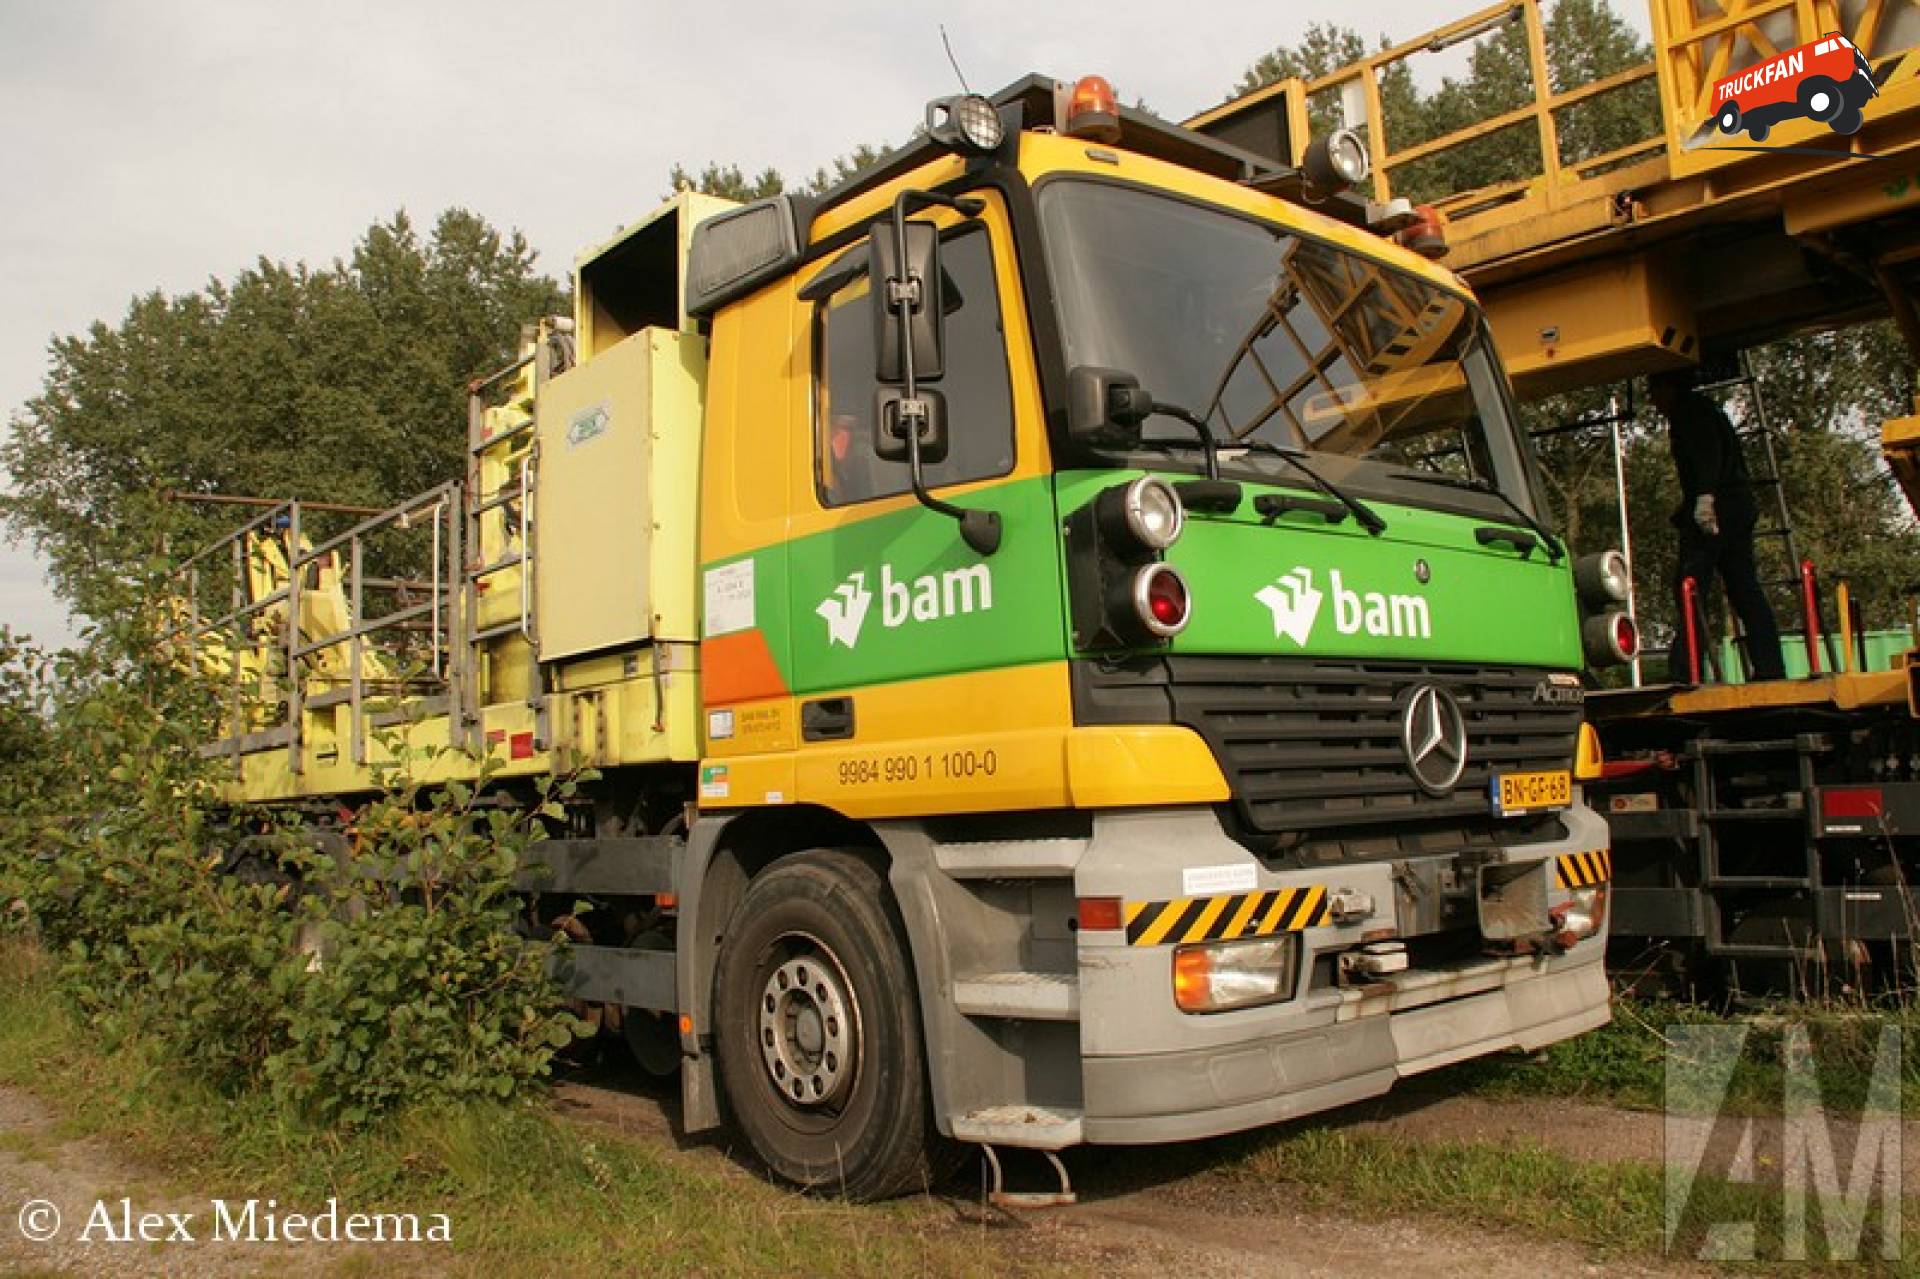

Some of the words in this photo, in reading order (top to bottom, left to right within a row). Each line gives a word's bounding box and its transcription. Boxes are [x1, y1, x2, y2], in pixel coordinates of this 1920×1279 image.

[881, 563, 992, 627] bam
[1329, 568, 1431, 640] bam
[839, 760, 879, 785] 9984
[885, 755, 918, 782] 990
[924, 755, 932, 780] 1
[942, 749, 997, 778] 100-0
